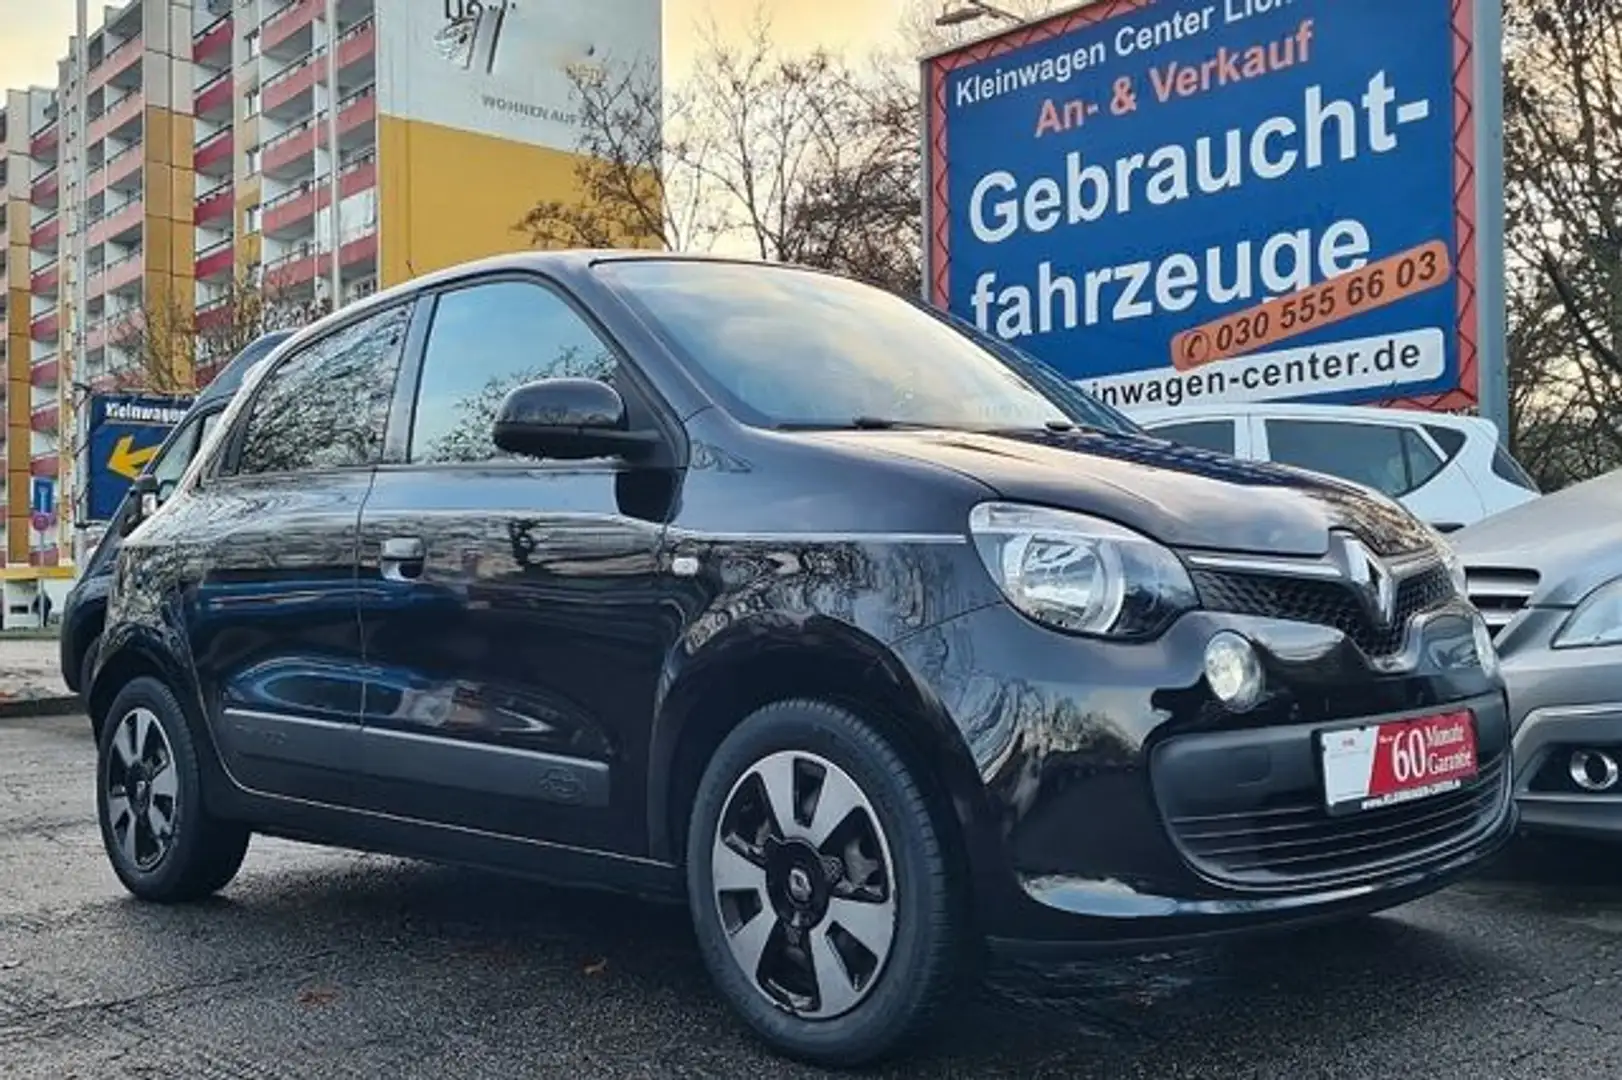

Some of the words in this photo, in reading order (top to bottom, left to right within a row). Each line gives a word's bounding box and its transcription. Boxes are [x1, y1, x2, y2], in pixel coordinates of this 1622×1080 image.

[956, 41, 1106, 107] Kleinwagen
[1114, 5, 1215, 56] Center
[1034, 98, 1099, 138] An-
[1109, 76, 1137, 116] &
[1149, 18, 1314, 102] Verkauf
[969, 69, 1429, 244] Gebraucht-
[970, 217, 1370, 342] fahrzeuge
[1216, 311, 1269, 351] 030
[1280, 287, 1335, 330] 555
[1347, 269, 1384, 306] 66
[1396, 250, 1436, 288] 03
[1092, 338, 1420, 407] inwagen-center.de
[1393, 728, 1426, 782] 60
